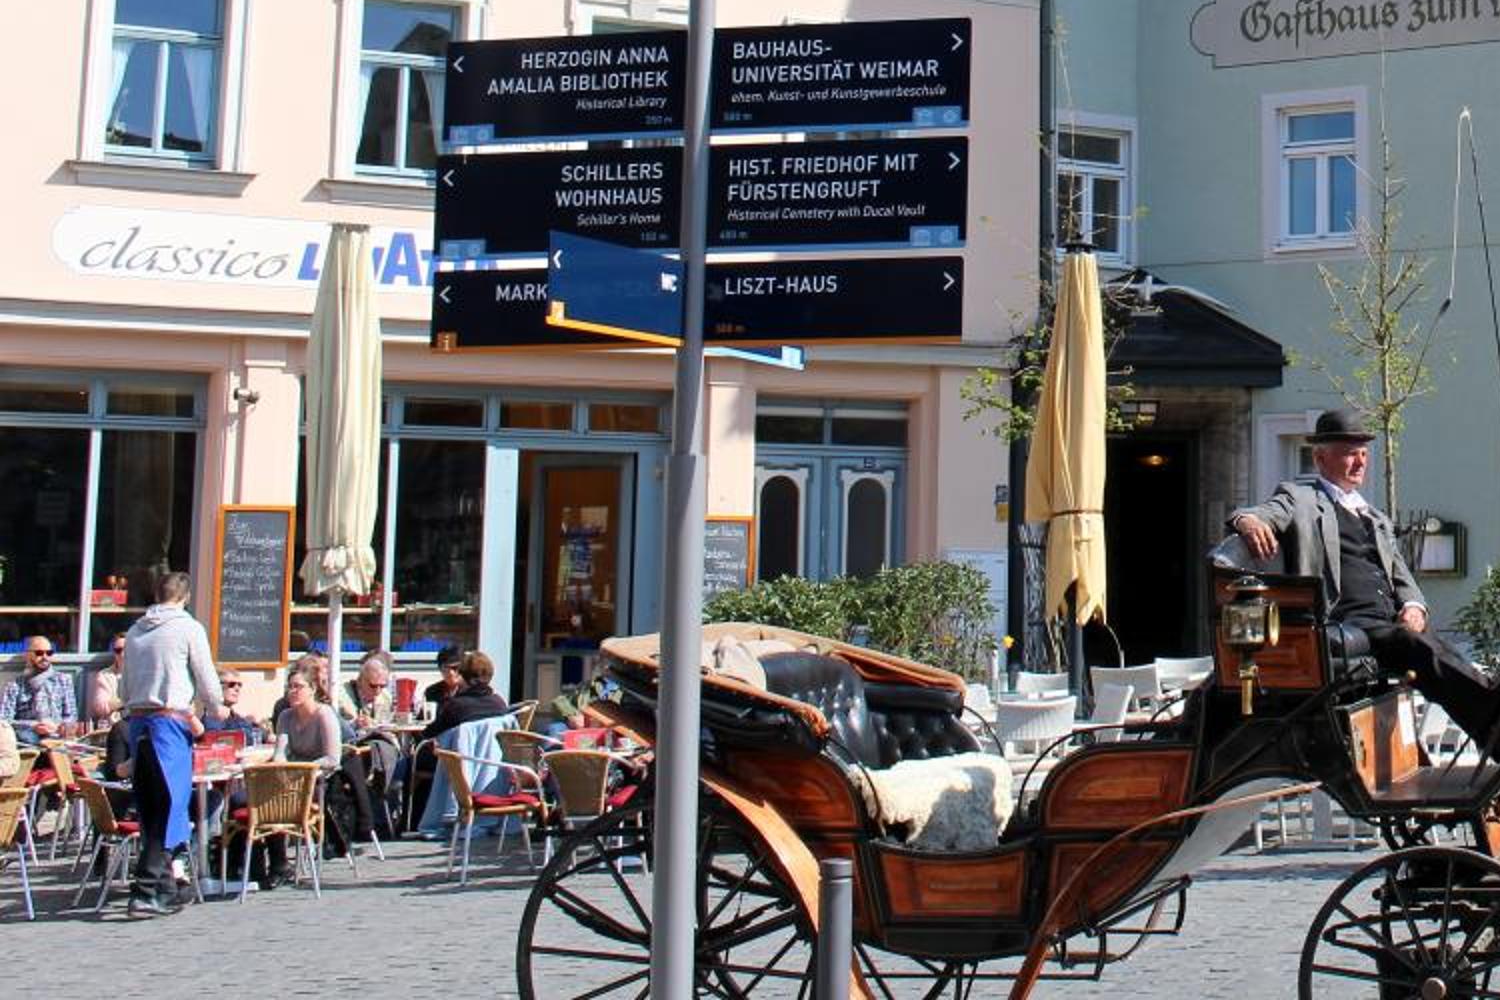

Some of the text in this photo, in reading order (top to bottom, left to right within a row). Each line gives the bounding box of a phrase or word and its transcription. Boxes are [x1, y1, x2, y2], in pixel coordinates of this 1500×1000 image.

[521, 46, 669, 69] HERZOGIN ANNA
[733, 39, 832, 60] BAUHAUS-
[731, 59, 939, 84] UNIVERSITÄT WEIMAR
[487, 70, 668, 96] AMALIA BIBLIOTHEK
[807, 88, 829, 100] und
[830, 85, 947, 101] Kunstgewerbeschule
[576, 96, 667, 111] Historical Library
[561, 162, 663, 183] SCHILLERS
[729, 153, 919, 176] HIST. FRIEDHOF MIT
[555, 187, 663, 208] WOHNHAUS
[727, 180, 881, 202] FÜRSTENGRUFT
[630, 212, 661, 225] Home
[727, 203, 926, 221] Historical Cemetery with Ducal Vault
[79, 226, 291, 280] classico
[724, 275, 838, 296] LISZT-HAUS
